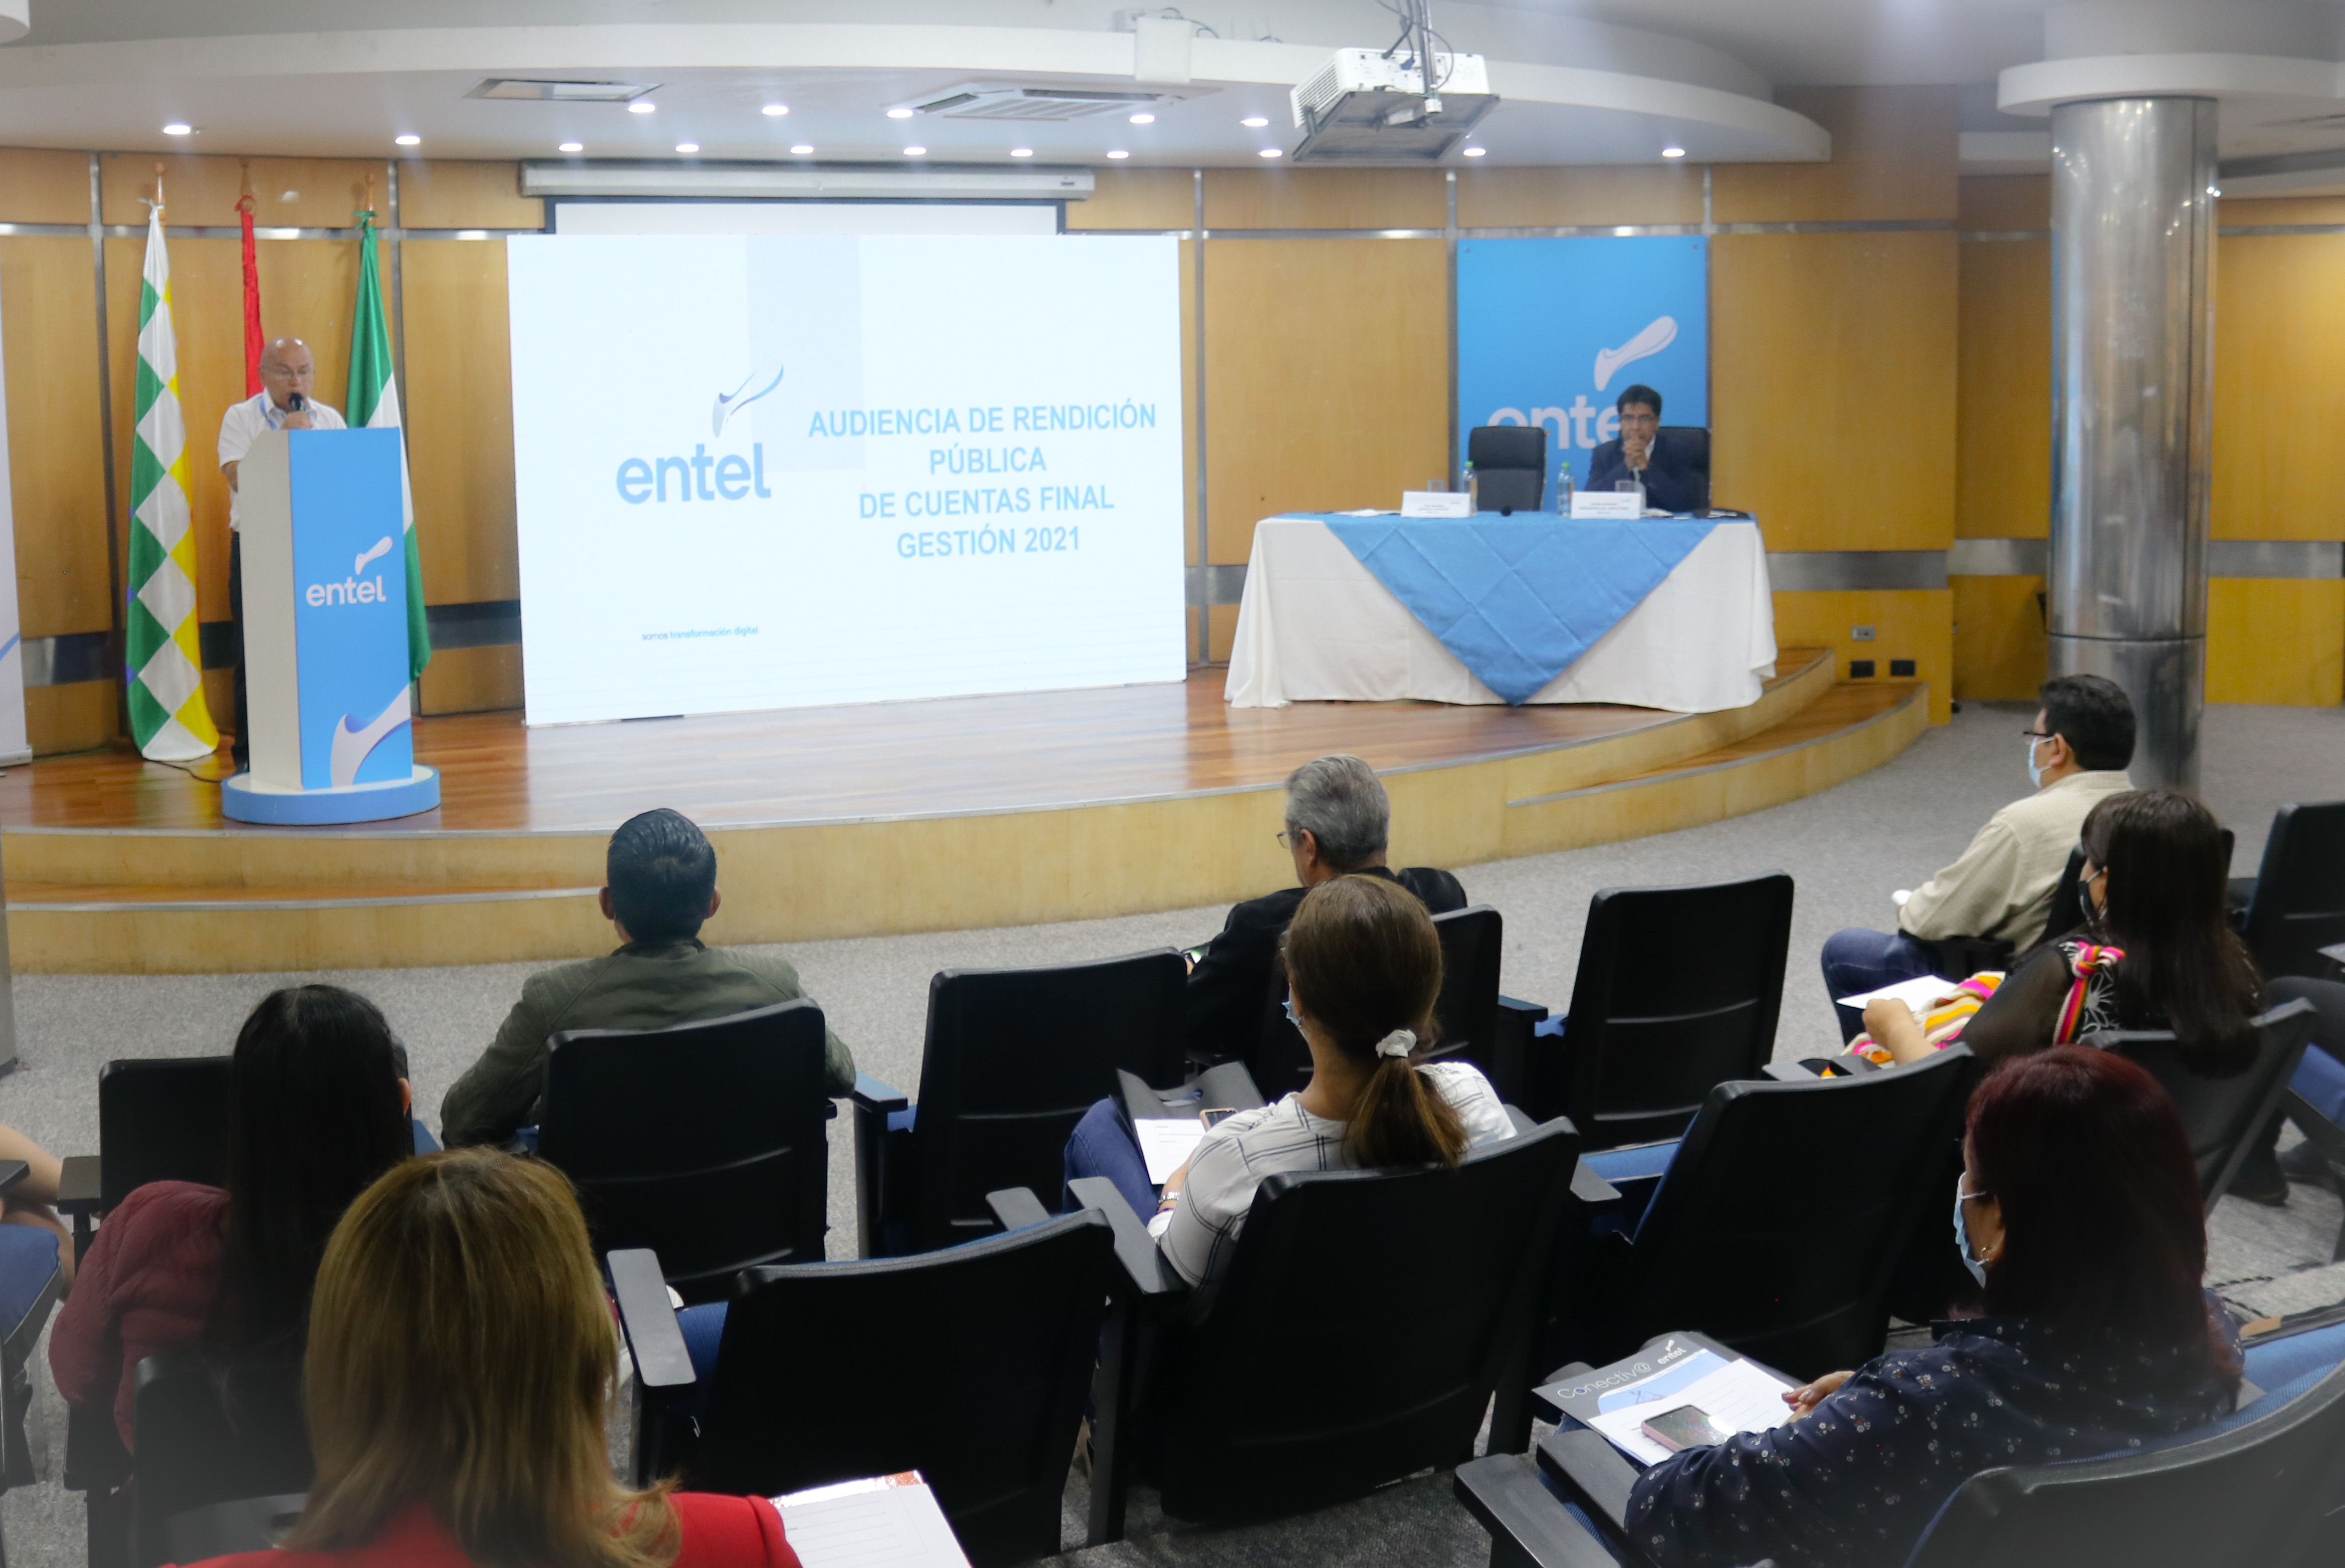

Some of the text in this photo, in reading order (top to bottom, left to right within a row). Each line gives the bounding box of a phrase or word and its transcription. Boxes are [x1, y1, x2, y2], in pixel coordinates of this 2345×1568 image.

[807, 397, 1156, 438] AUDIENCIA DE RENDICIÓN
[615, 442, 772, 505] entel
[929, 441, 1047, 475] PÚBLICA
[859, 484, 1115, 519] DE CUENTAS FINAL
[896, 523, 1080, 559] GESTIÓN 2021
[305, 575, 386, 607] entel
[642, 626, 759, 641] somos transformación digital
[1657, 1347, 1687, 1365] entel
[1557, 1362, 1652, 1399] Conectiv@
